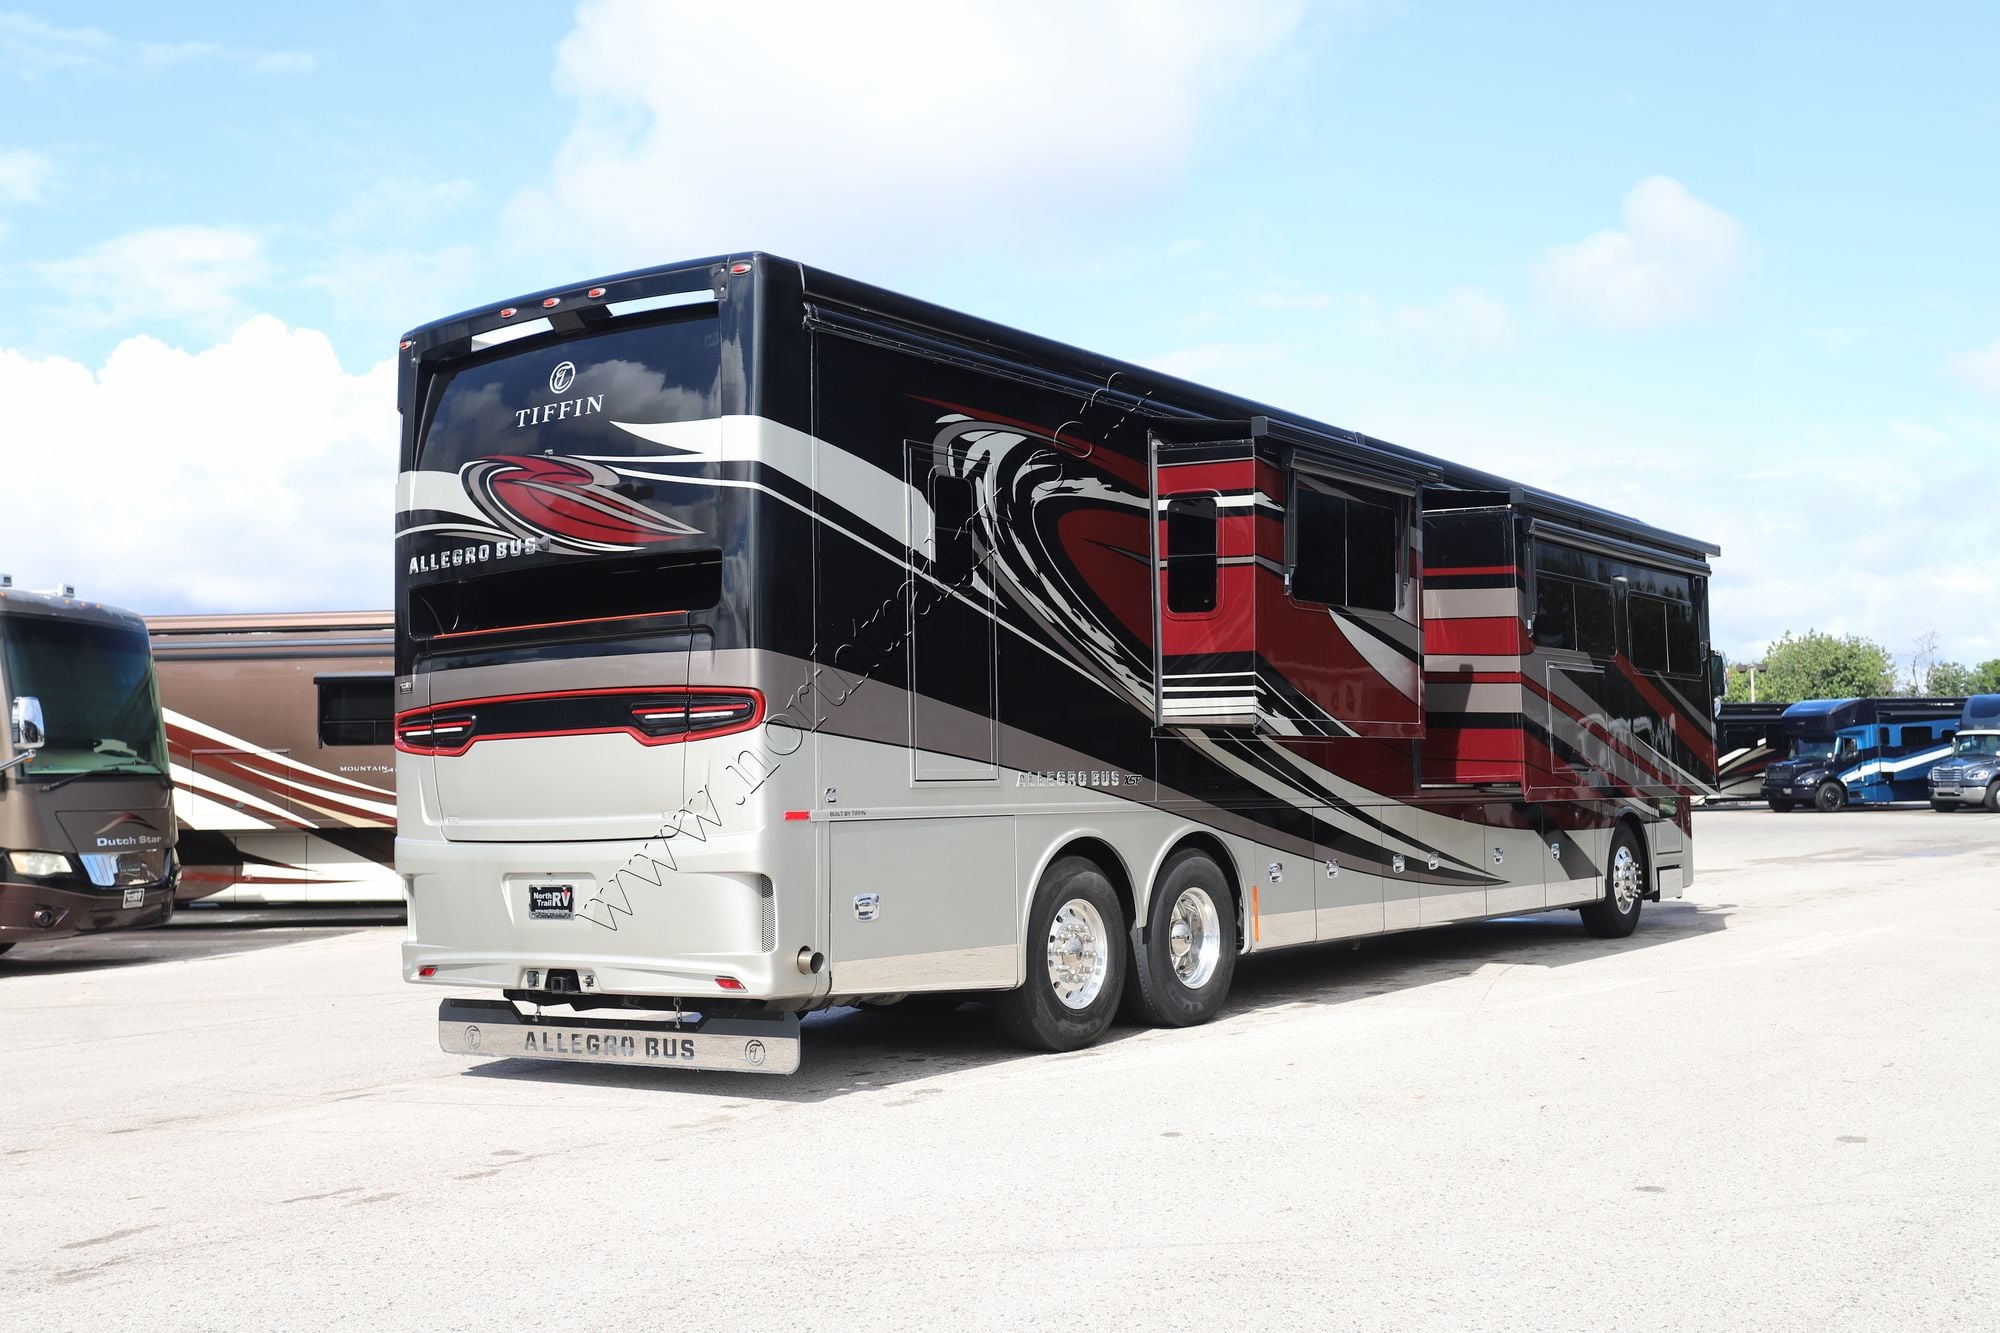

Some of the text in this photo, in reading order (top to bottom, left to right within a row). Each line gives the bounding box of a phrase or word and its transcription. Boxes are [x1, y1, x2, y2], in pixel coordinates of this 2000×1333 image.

[515, 394, 605, 428] TIFFIN
[409, 537, 536, 575] ALLEGRO BUS
[1016, 770, 1143, 788] ALLEGRO BUS XSP
[96, 835, 162, 847] Dutch Star
[533, 890, 571, 907] North RV
[536, 899, 552, 907] Trail
[524, 1031, 695, 1060] ALLEGRO BUS
